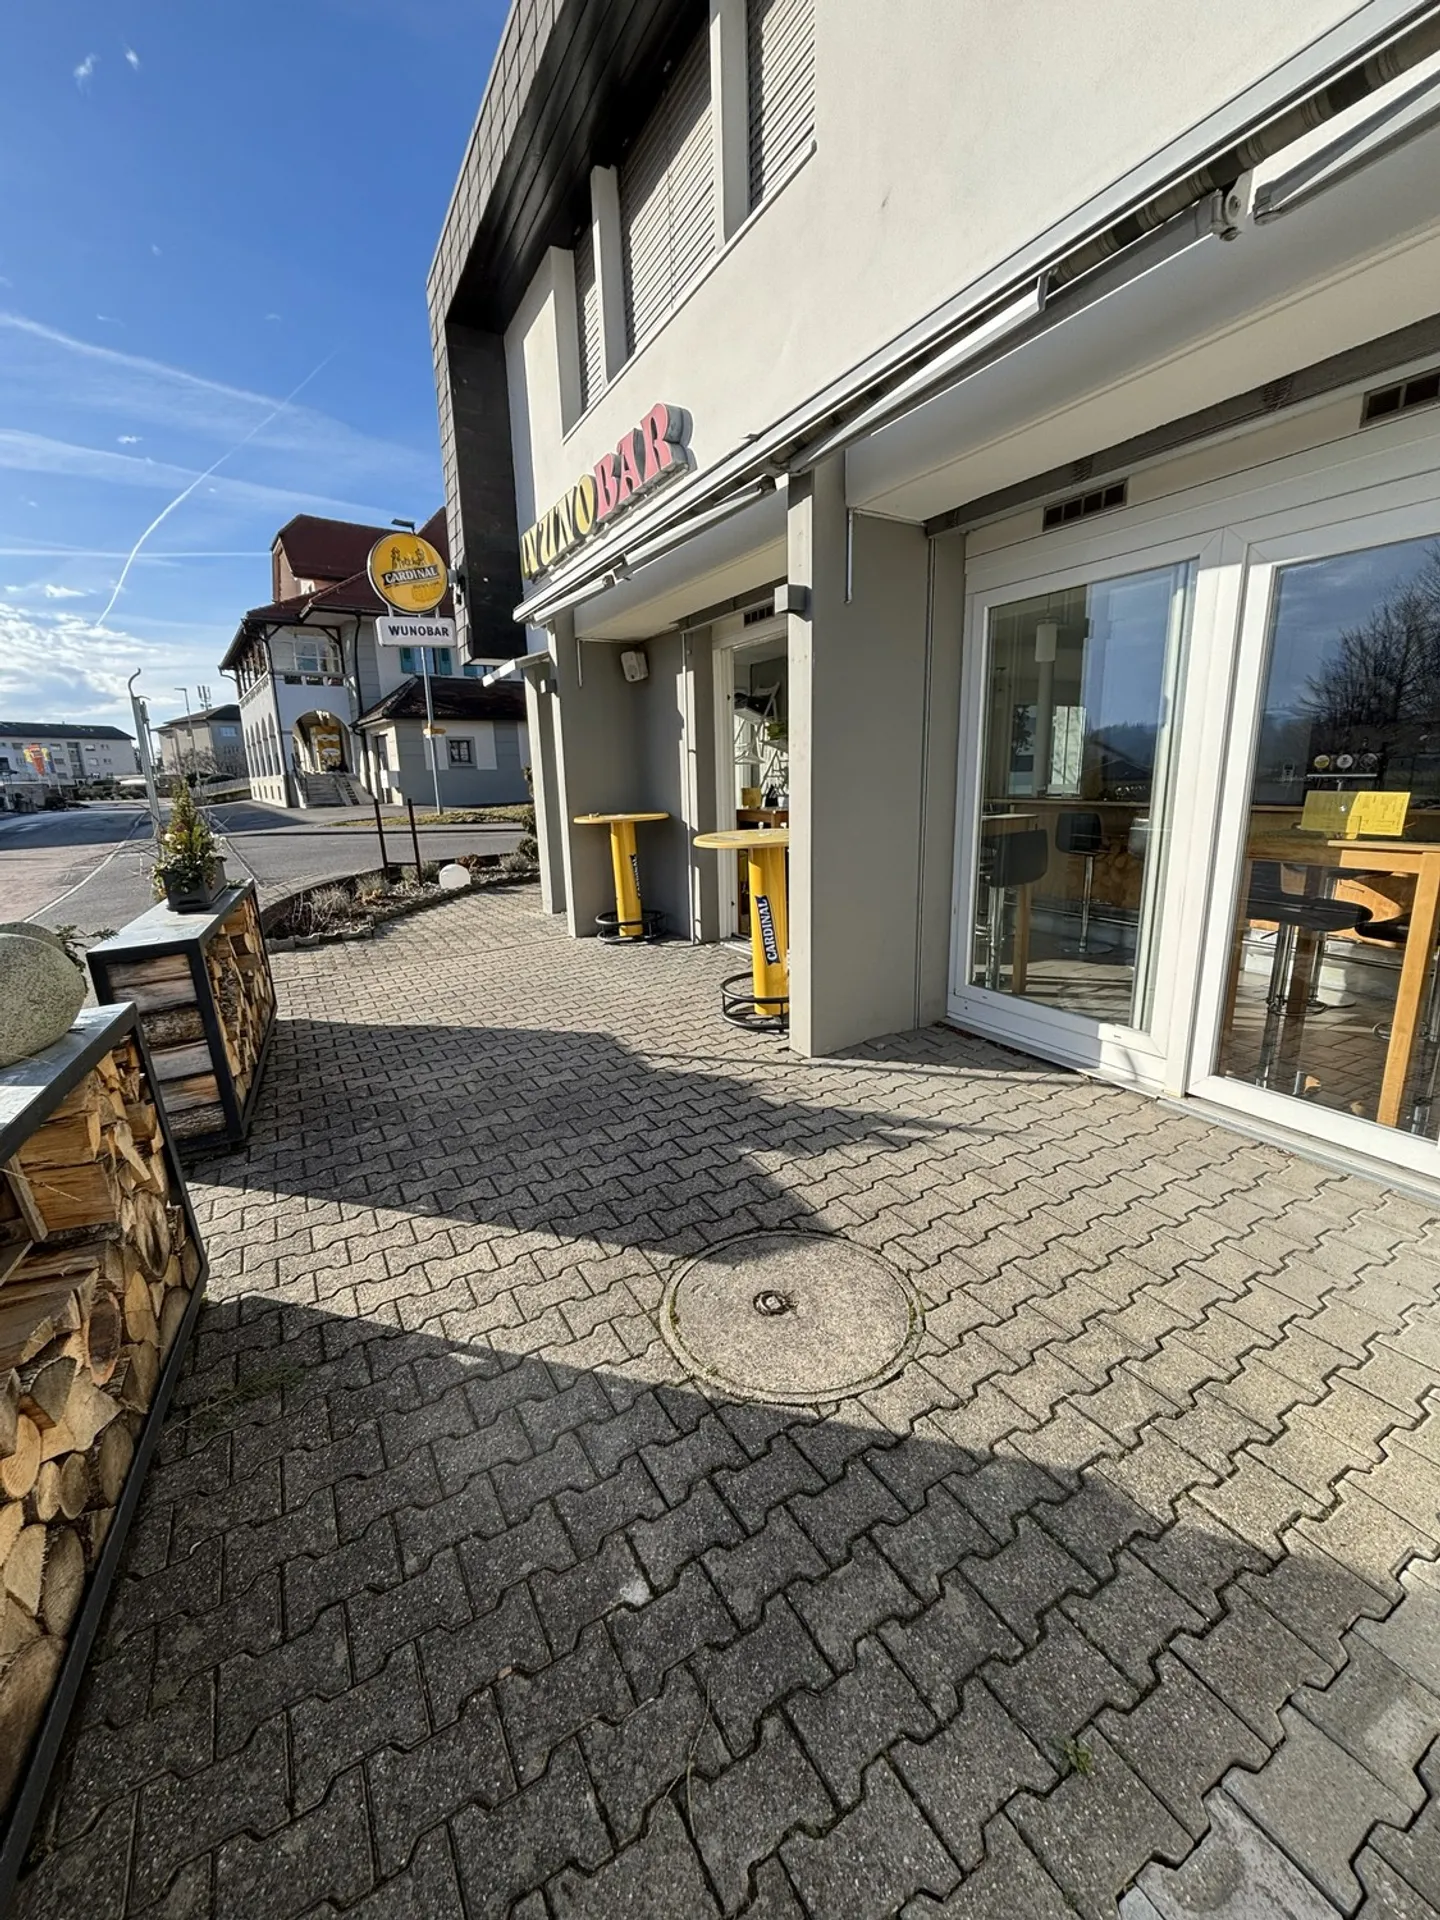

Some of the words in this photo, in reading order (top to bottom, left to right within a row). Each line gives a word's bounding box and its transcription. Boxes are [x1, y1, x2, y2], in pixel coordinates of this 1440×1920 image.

[384, 566, 438, 584] CARDINAL
[388, 624, 449, 637] WUNOBAR
[758, 898, 778, 962] CARDINAL
